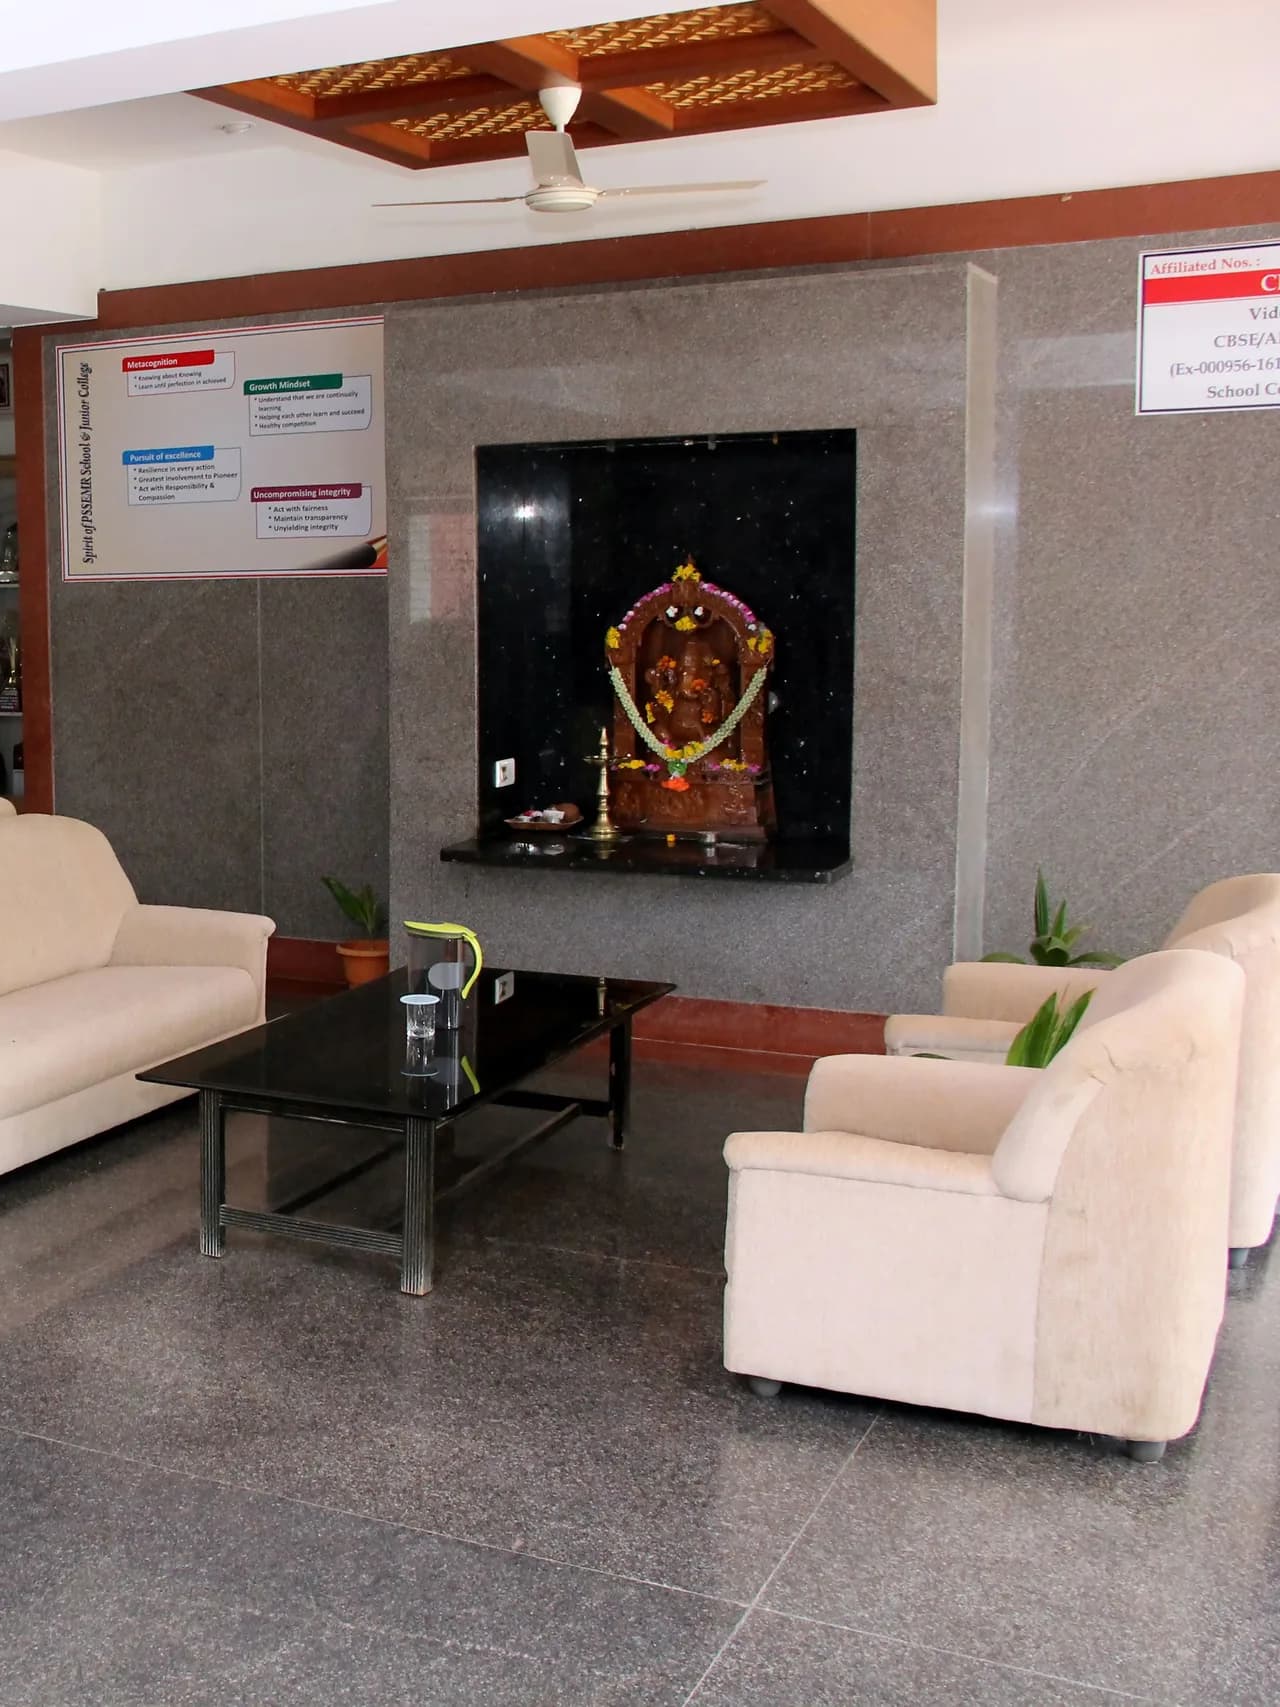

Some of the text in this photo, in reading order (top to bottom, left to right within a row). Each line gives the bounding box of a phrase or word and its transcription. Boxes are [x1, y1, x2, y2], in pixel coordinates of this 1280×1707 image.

[1151, 260, 1216, 275] Affiliated
[1221, 258, 1252, 269] Nos.
[1250, 306, 1280, 320] Vid
[1214, 332, 1280, 348] CBSE/A
[127, 358, 177, 369] Metacognition
[77, 362, 92, 398] College
[138, 375, 160, 383] Knowing
[179, 371, 201, 379] Knowing
[168, 380, 194, 388] perfection
[249, 380, 310, 391] Growth Mindset
[1207, 383, 1280, 399] School C
[79, 400, 92, 430] Junior
[80, 444, 91, 475] School
[165, 452, 201, 460] excellence
[165, 484, 208, 492] Responsibility
[80, 477, 92, 523] PSSEMR
[138, 494, 175, 502] Compassion
[254, 490, 317, 499] Uncompromising
[304, 514, 348, 522] transparency
[82, 524, 96, 535] of
[274, 524, 309, 532] Unyielding
[82, 537, 96, 564] Spirit
